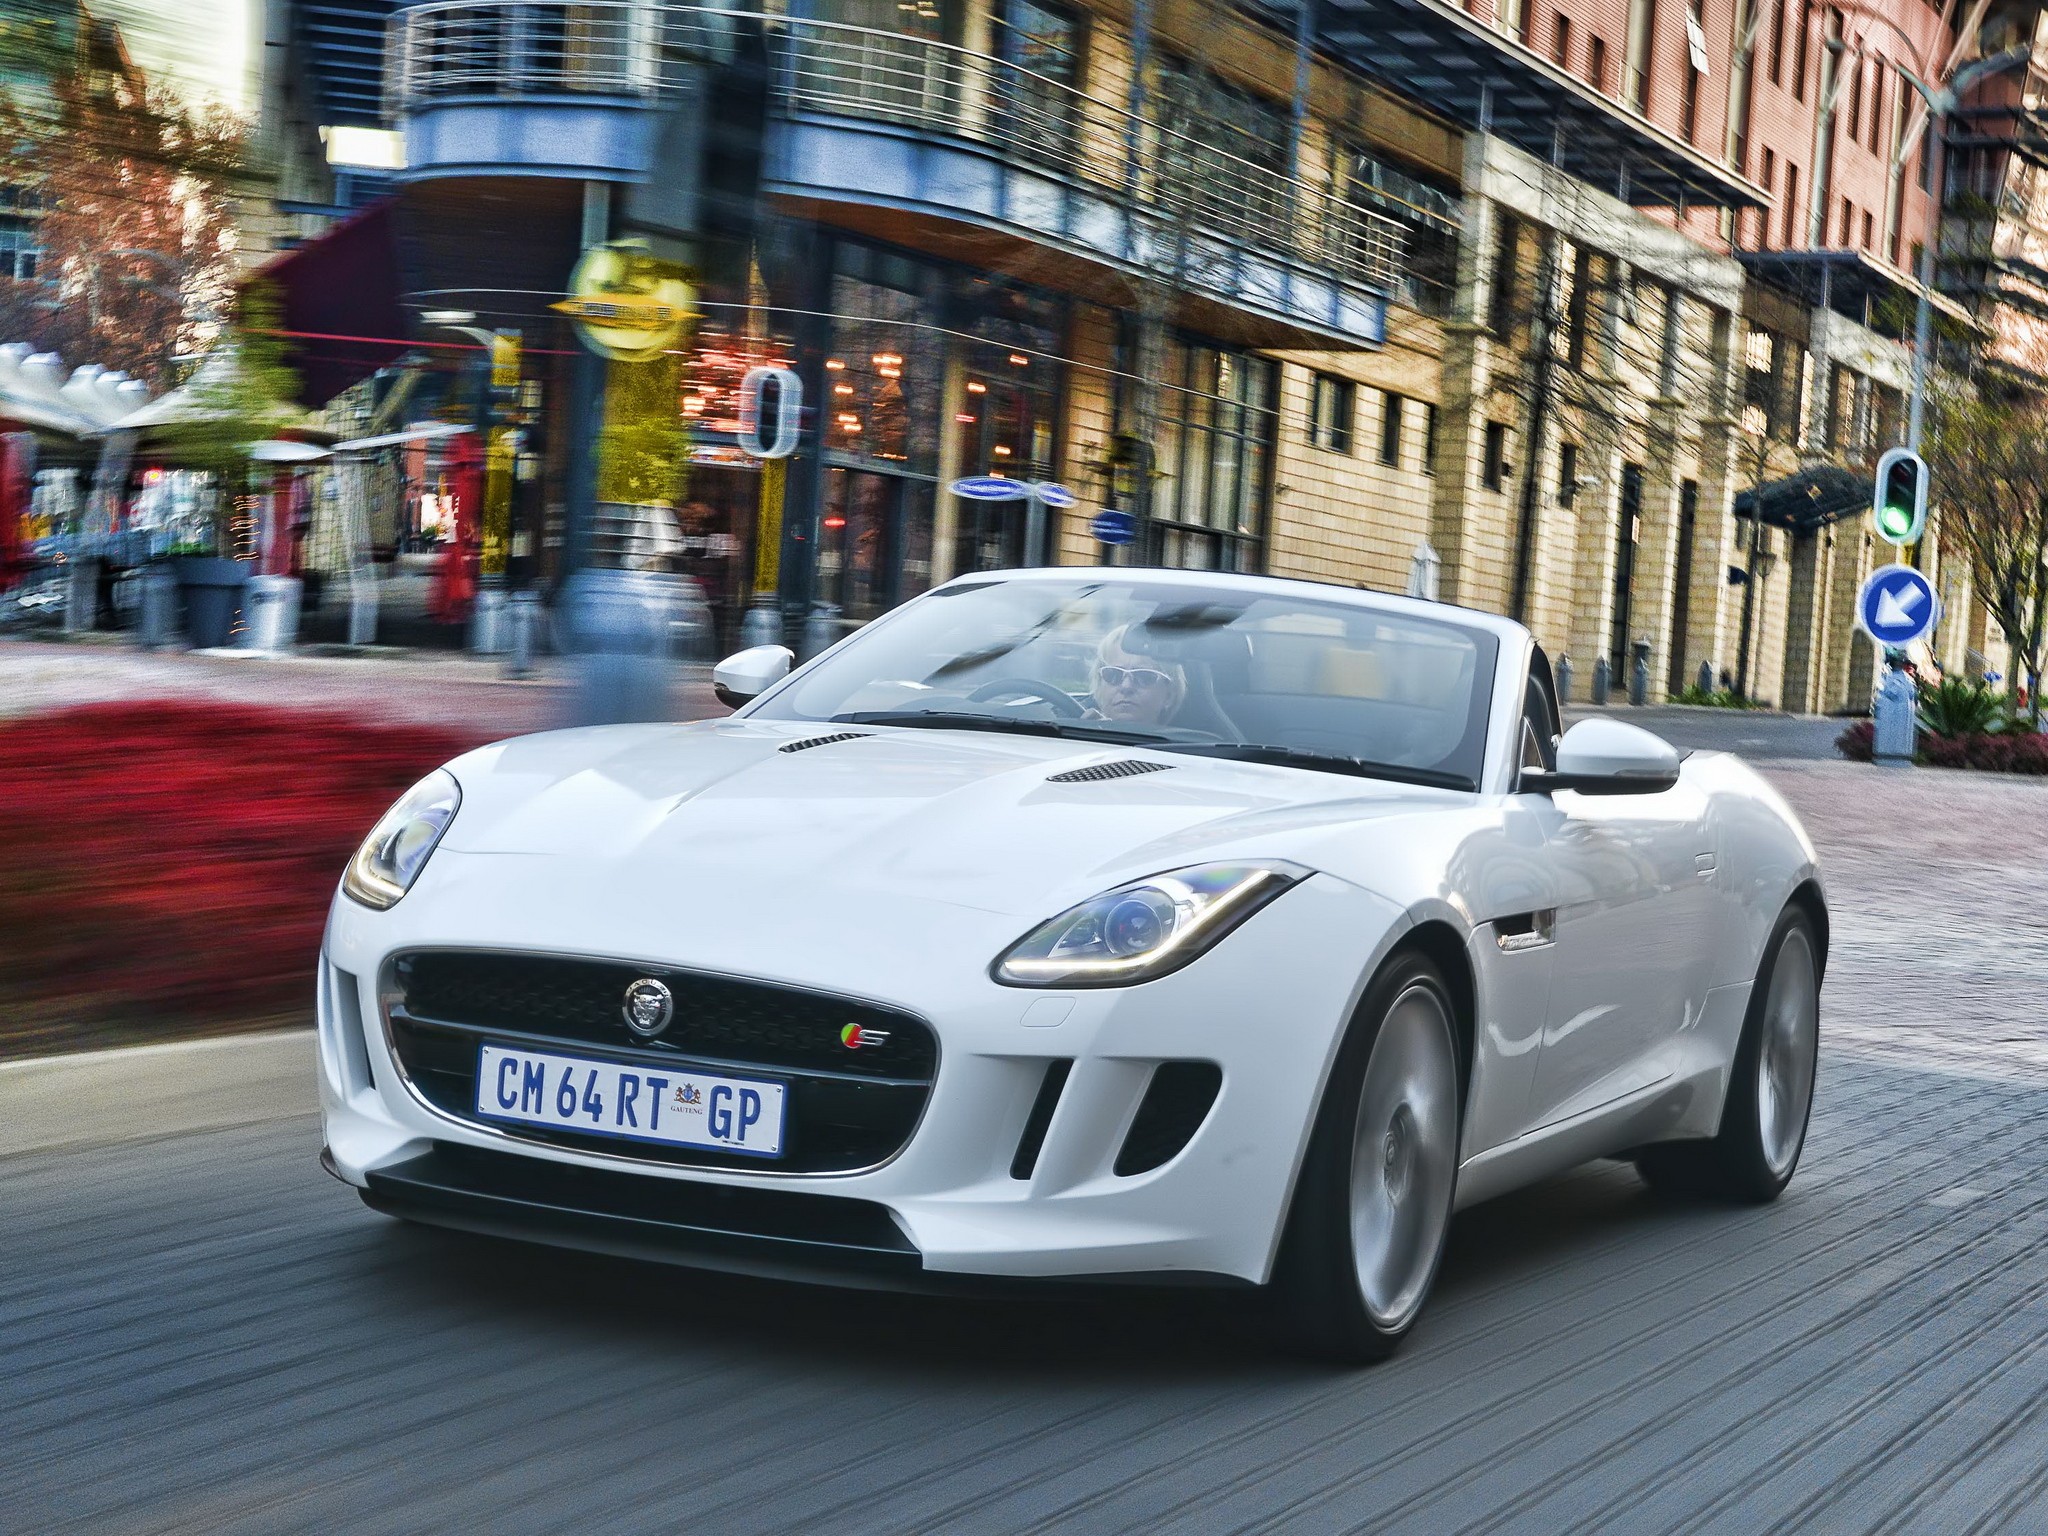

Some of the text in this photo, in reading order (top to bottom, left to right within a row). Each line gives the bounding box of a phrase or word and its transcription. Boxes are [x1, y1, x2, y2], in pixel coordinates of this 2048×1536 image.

[497, 1057, 761, 1142] CM 64 RT GP
[670, 1105, 703, 1115] GAUTENG
